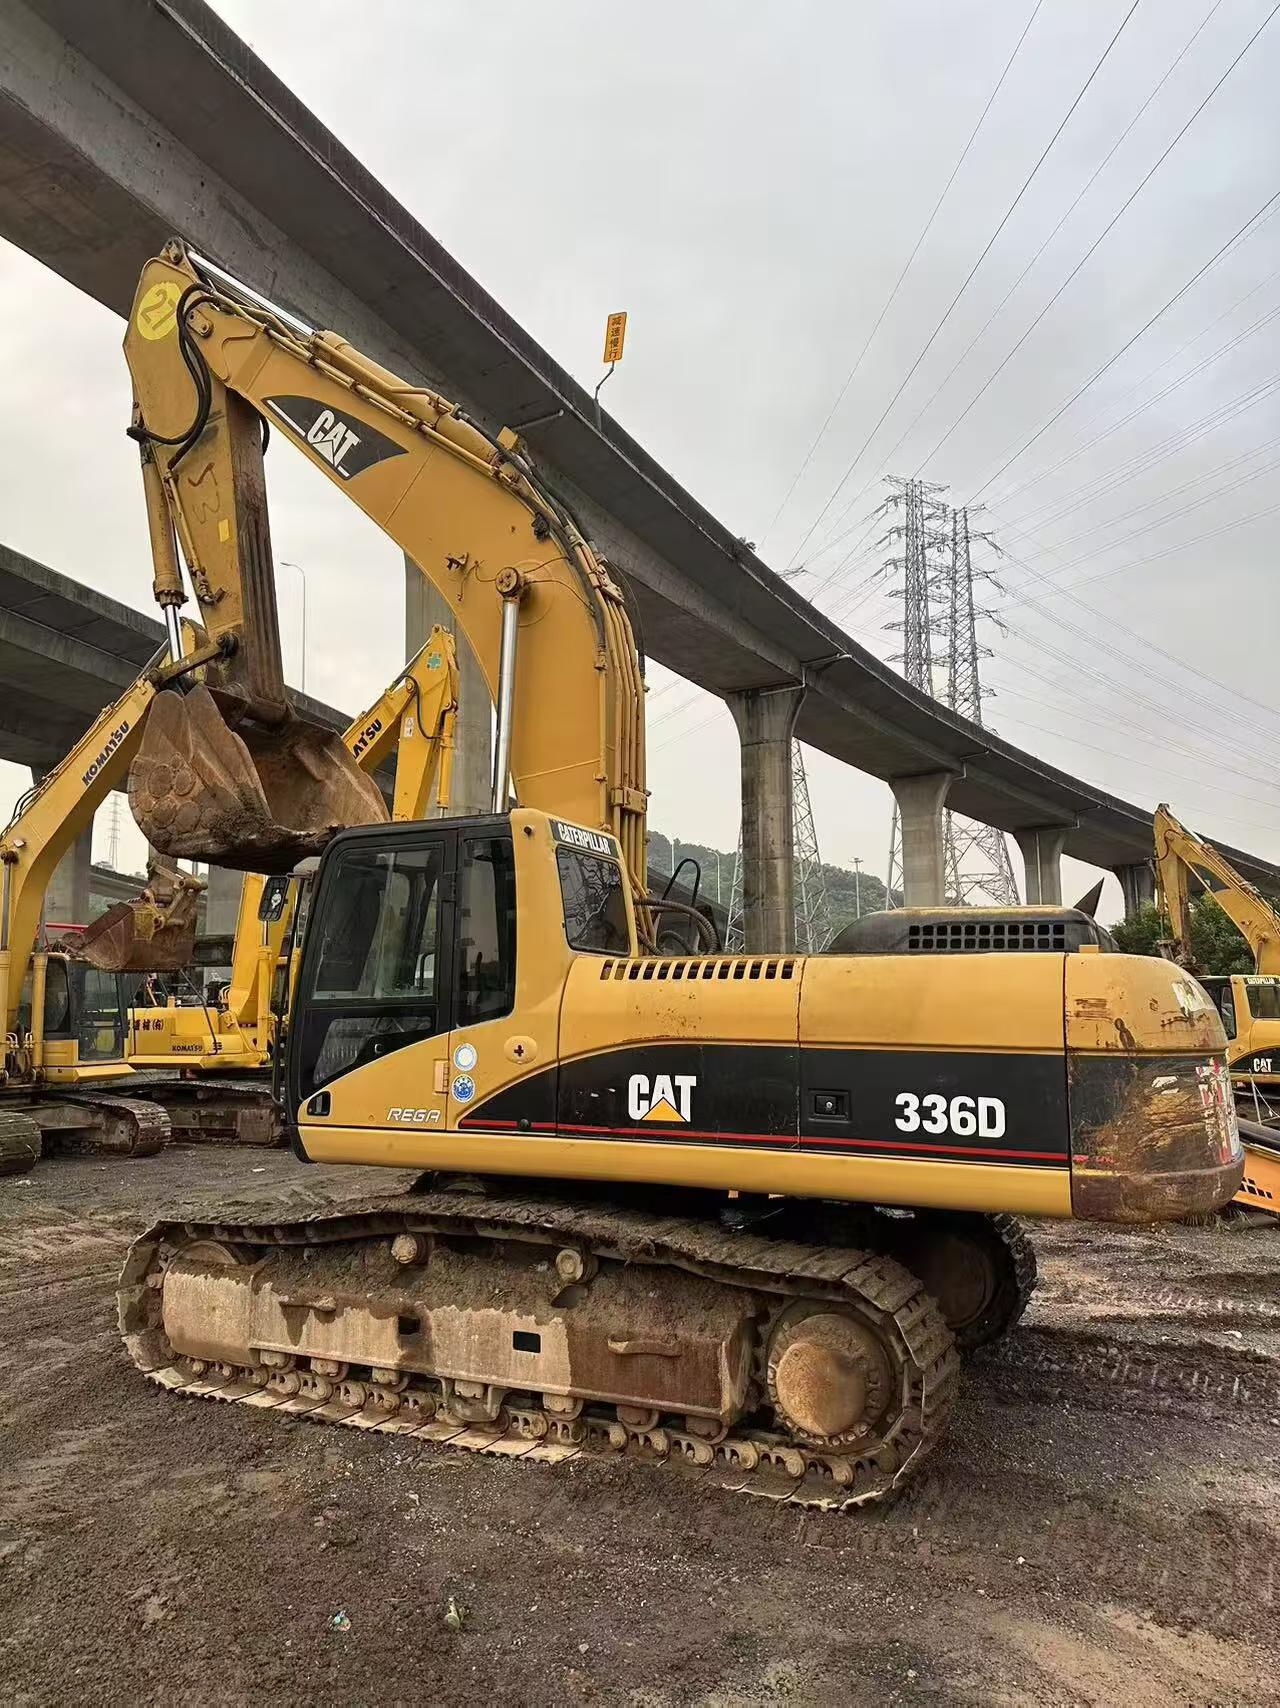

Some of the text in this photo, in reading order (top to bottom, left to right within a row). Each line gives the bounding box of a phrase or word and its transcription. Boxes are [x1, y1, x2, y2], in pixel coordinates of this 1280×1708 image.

[307, 409, 361, 468] CAT
[82, 720, 130, 786] KOMATSU
[352, 718, 382, 760] ATSU
[557, 822, 612, 855] CATERPILLAR
[171, 1043, 204, 1052] KOMATSU
[1253, 1058, 1273, 1073] CAT
[386, 1106, 441, 1123] REGA
[628, 1074, 697, 1122] CAT
[894, 1092, 1006, 1139] 336D
